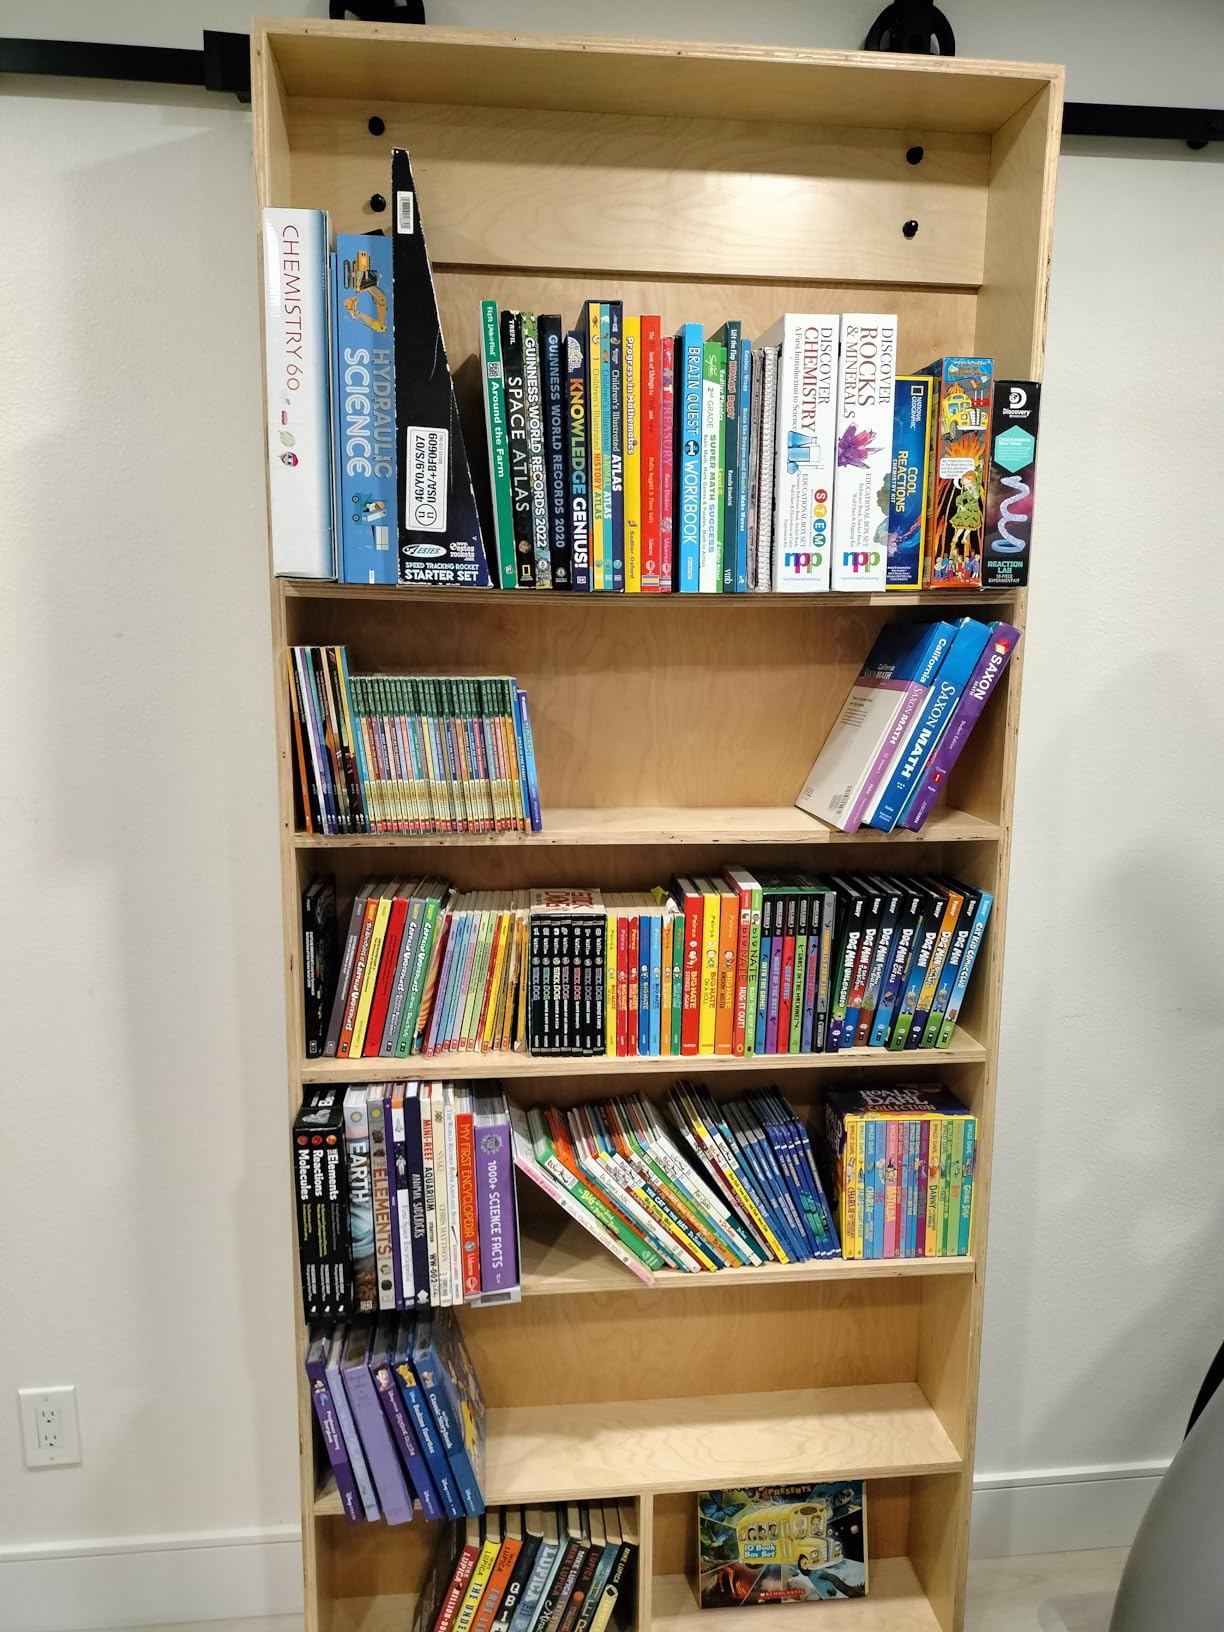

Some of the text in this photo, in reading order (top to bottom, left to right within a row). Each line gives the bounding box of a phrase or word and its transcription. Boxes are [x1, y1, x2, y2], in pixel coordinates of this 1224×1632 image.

[282, 225, 303, 391] CHEMISTRY 60
[728, 350, 736, 361] Flap
[729, 329, 737, 340] Lift
[793, 333, 802, 349] First
[728, 361, 737, 393] HUMAN
[792, 351, 801, 395] Introduction
[801, 327, 819, 433] CHEMISTRY
[818, 327, 833, 404] DISCOVER
[843, 325, 857, 419] & MINERALS
[856, 326, 878, 407] ROCKS
[878, 327, 893, 404] DISCOVER
[345, 347, 370, 477] SCIENCE
[372, 348, 392, 479] HYDRAULIC
[625, 336, 636, 455] Progress in Mathematics
[687, 347, 700, 435] BRAIN QUEST
[727, 395, 735, 419] BODY
[1002, 408, 1031, 417] Discovery
[491, 381, 506, 478] Around the Farm
[611, 369, 622, 491] Children's Illustrated ATLAS
[791, 404, 799, 431] Science
[508, 376, 529, 512] SPACE ATLAS
[524, 337, 547, 548] GUINNESS WORLD RECORDS 2022
[548, 335, 565, 548] GUINNESS WORLD RECORDS 2020
[592, 368, 602, 520] Children's Illustrated HISTORY ATLAS
[415, 436, 425, 502] 4G/Y0.9/S/07
[427, 433, 437, 503] USA/+BF0609
[569, 378, 587, 569] KNOWLEDGE GENIUS!
[708, 472, 716, 501] MATH
[896, 451, 909, 512] REACTIONS
[907, 467, 918, 496] COOL
[683, 460, 698, 544] WORKBOOK
[405, 569, 478, 581] STARTER SET
[724, 569, 732, 584] vmb
[920, 639, 947, 683] California
[973, 654, 1003, 701] SAXON
[890, 686, 923, 745] SAXON MATH
[928, 681, 955, 727] SAXON
[901, 727, 932, 779] MATH
[844, 932, 860, 967] DOG MAN
[860, 929, 876, 963] DOG MAN
[876, 928, 893, 962] DOG MAN
[895, 929, 913, 963] DOG MAN
[917, 932, 936, 967] DOG MAN
[933, 931, 951, 965] DOG MAN
[949, 931, 969, 965] DOG MAN
[958, 922, 983, 988] CAT KID COMIC CLUB
[838, 968, 851, 1008] UNLEASHED
[863, 1096, 928, 1105] DAHL
[298, 1149, 310, 1200] Molecules
[313, 1149, 324, 1196] Reactions
[328, 1155, 339, 1200] Elements
[349, 1142, 369, 1203] EARTH
[423, 1119, 434, 1211] MINI-REEF AQUARIUM
[460, 1124, 475, 1237] MY FIRST ENCYCLOPEDIA
[372, 1168, 392, 1255] ELEMENTS
[412, 1173, 424, 1238] ANIMAL SIDEKICKS
[487, 1160, 503, 1268] 1000+ SCIENCE FACTS
[646, 1187, 688, 1230] THE CAT IN THE HAT
[865, 1186, 873, 1213] CHARLIE
[886, 1186, 896, 1222] MATILDA
[929, 1185, 937, 1209] DANNY
[467, 1252, 475, 1276] Usborne
[429, 1393, 452, 1449] Classic Storybook
[767, 1486, 812, 1495] PRESENTS
[454, 1551, 471, 1582] LUPICA
[477, 1551, 491, 1576] LUPICA
[561, 1550, 585, 1596] MIKE LUPICA
[613, 1547, 630, 1583] MIKE LUPICA
